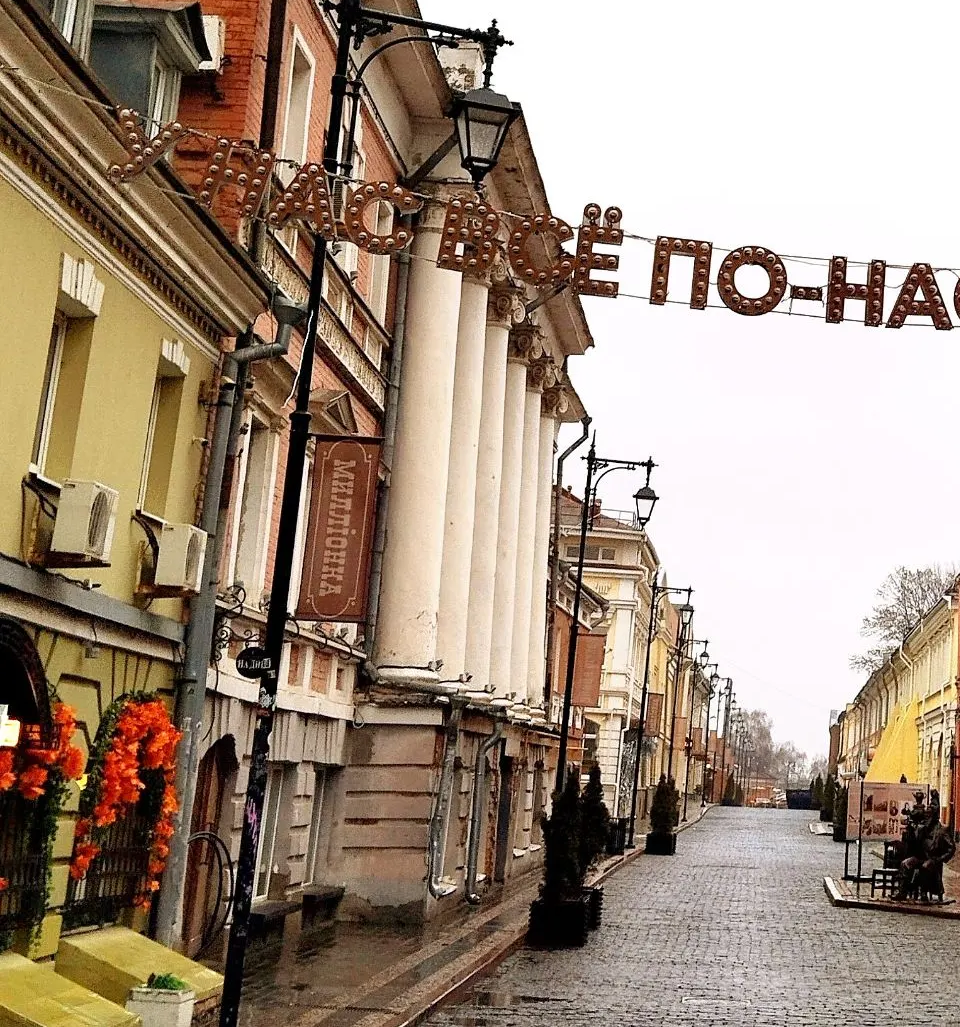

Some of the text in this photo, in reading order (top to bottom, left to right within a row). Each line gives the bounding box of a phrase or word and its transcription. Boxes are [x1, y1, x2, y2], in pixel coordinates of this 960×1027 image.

[106, 105, 188, 180] У
[199, 136, 423, 255] НАС
[437, 199, 624, 298] ВСЁ
